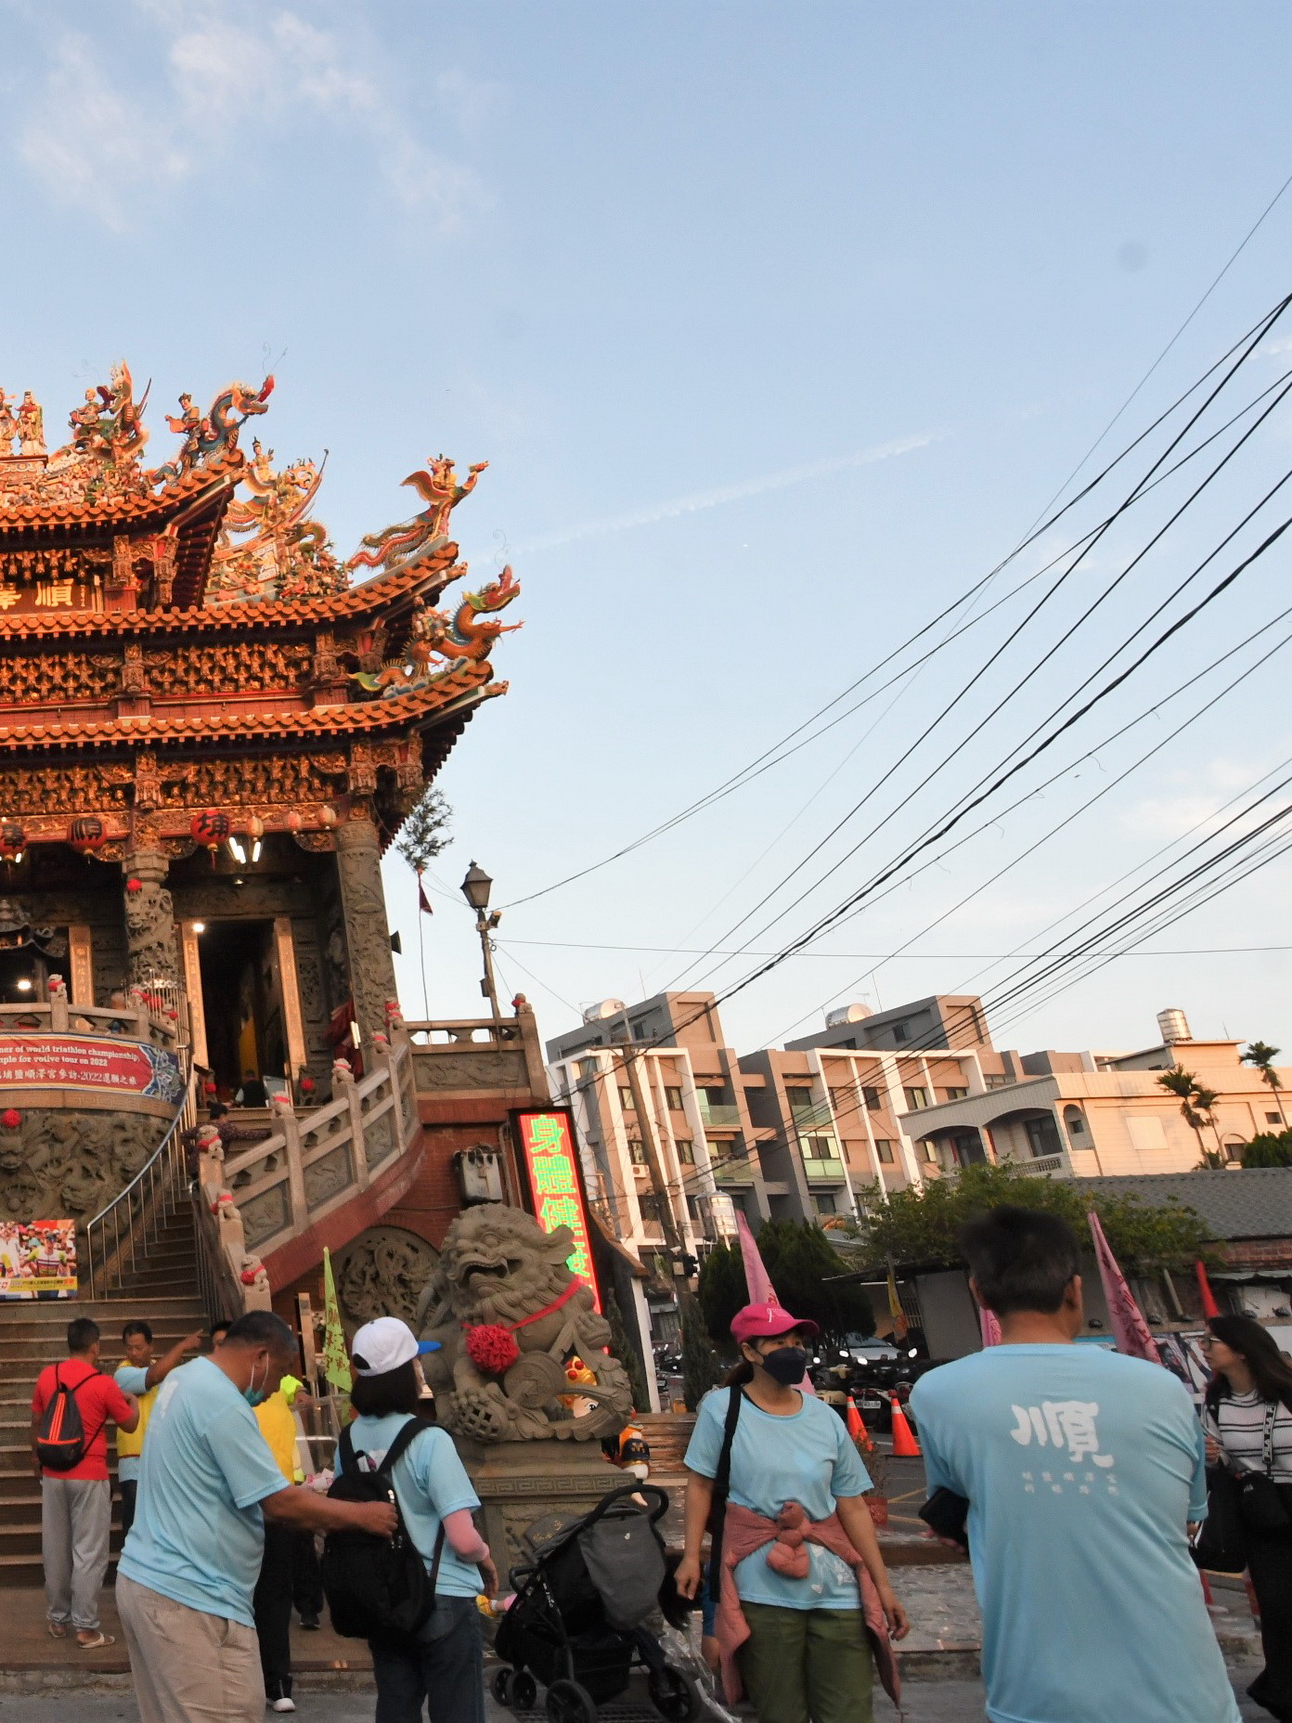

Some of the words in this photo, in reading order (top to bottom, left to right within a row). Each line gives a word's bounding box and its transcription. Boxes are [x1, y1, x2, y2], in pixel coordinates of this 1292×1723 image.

[198, 811, 231, 839] 埔
[18, 1055, 32, 1063] for
[33, 1055, 60, 1063] votive
[61, 1055, 78, 1064] tour
[90, 1058, 108, 1067] 2022
[25, 1045, 50, 1053] world
[52, 1045, 87, 1055] triathlon
[88, 1048, 141, 1063] championship,
